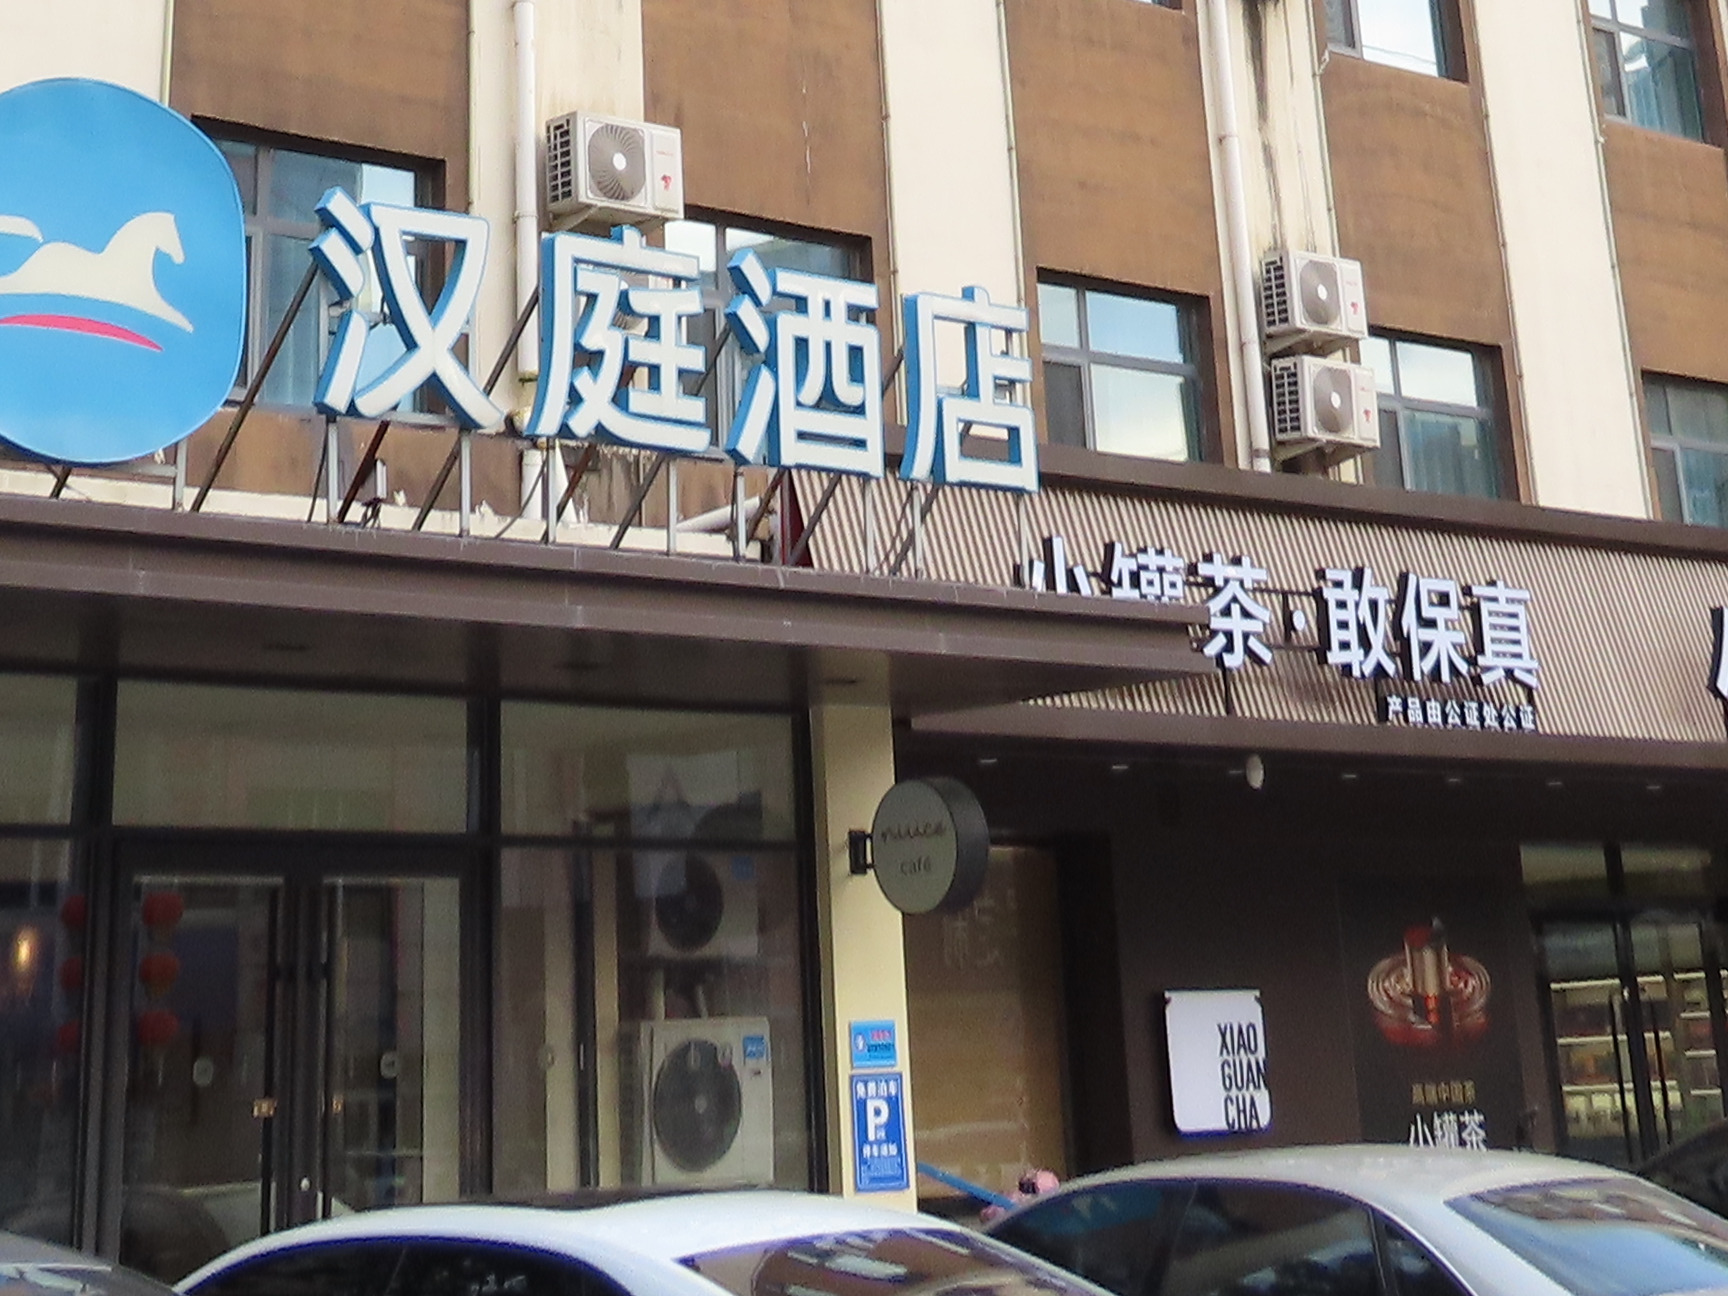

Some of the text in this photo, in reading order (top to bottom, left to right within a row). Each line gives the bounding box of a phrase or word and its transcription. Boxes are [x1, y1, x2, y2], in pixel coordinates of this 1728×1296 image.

[309, 186, 1041, 494] 汉庭酒店
[1217, 1022, 1259, 1057] XIAO
[1221, 1058, 1268, 1093] GUAN
[866, 1098, 889, 1141] P
[1224, 1094, 1261, 1131] CHA
